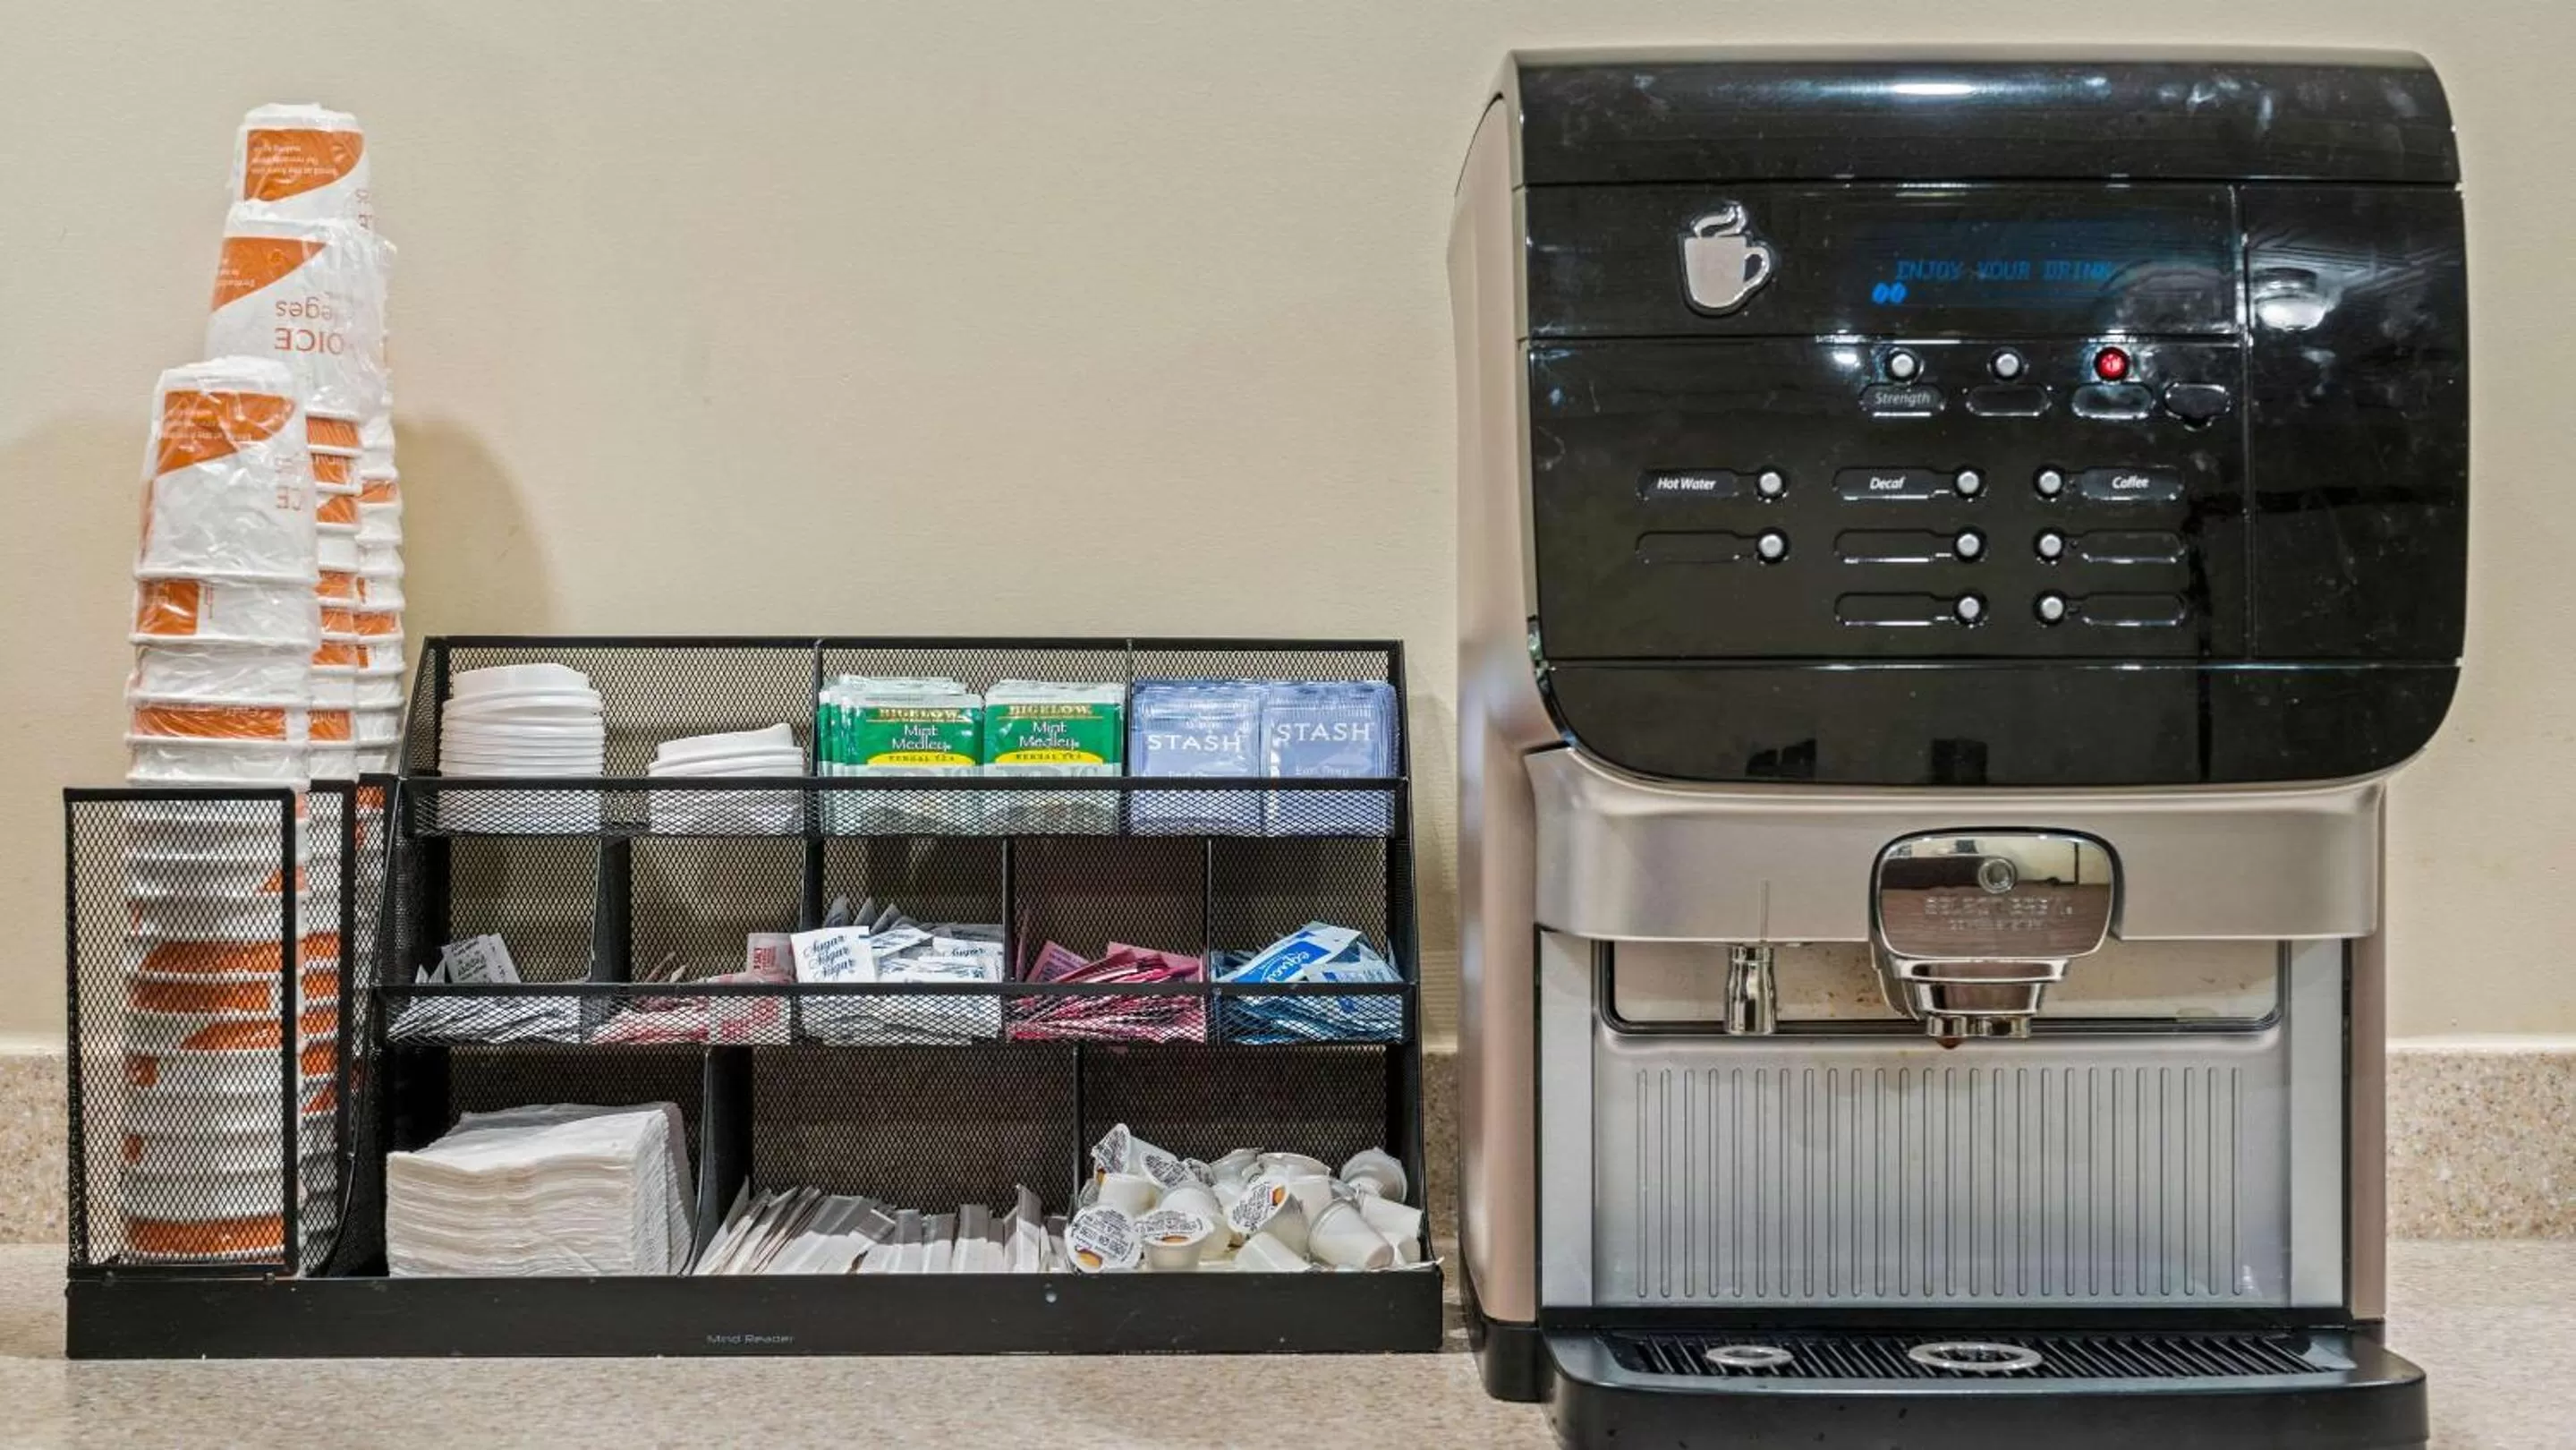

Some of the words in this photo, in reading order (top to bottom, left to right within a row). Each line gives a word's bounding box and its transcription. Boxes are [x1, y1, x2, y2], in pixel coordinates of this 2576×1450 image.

[1895, 260, 1965, 280] ENJOY
[1975, 260, 2031, 280] YOUR
[1874, 391, 1931, 407] Strength
[1657, 477, 1679, 490] Hot
[1681, 477, 1716, 490] Water
[1869, 475, 1906, 490] Decaf
[2112, 475, 2149, 490] Coffee
[880, 707, 959, 720] BIGELOW
[1008, 704, 1092, 716] BIGELOW
[904, 724, 938, 736] Mint
[1033, 721, 1067, 732] Mint
[1277, 722, 1373, 742] STASH
[1147, 733, 1243, 753] STASH
